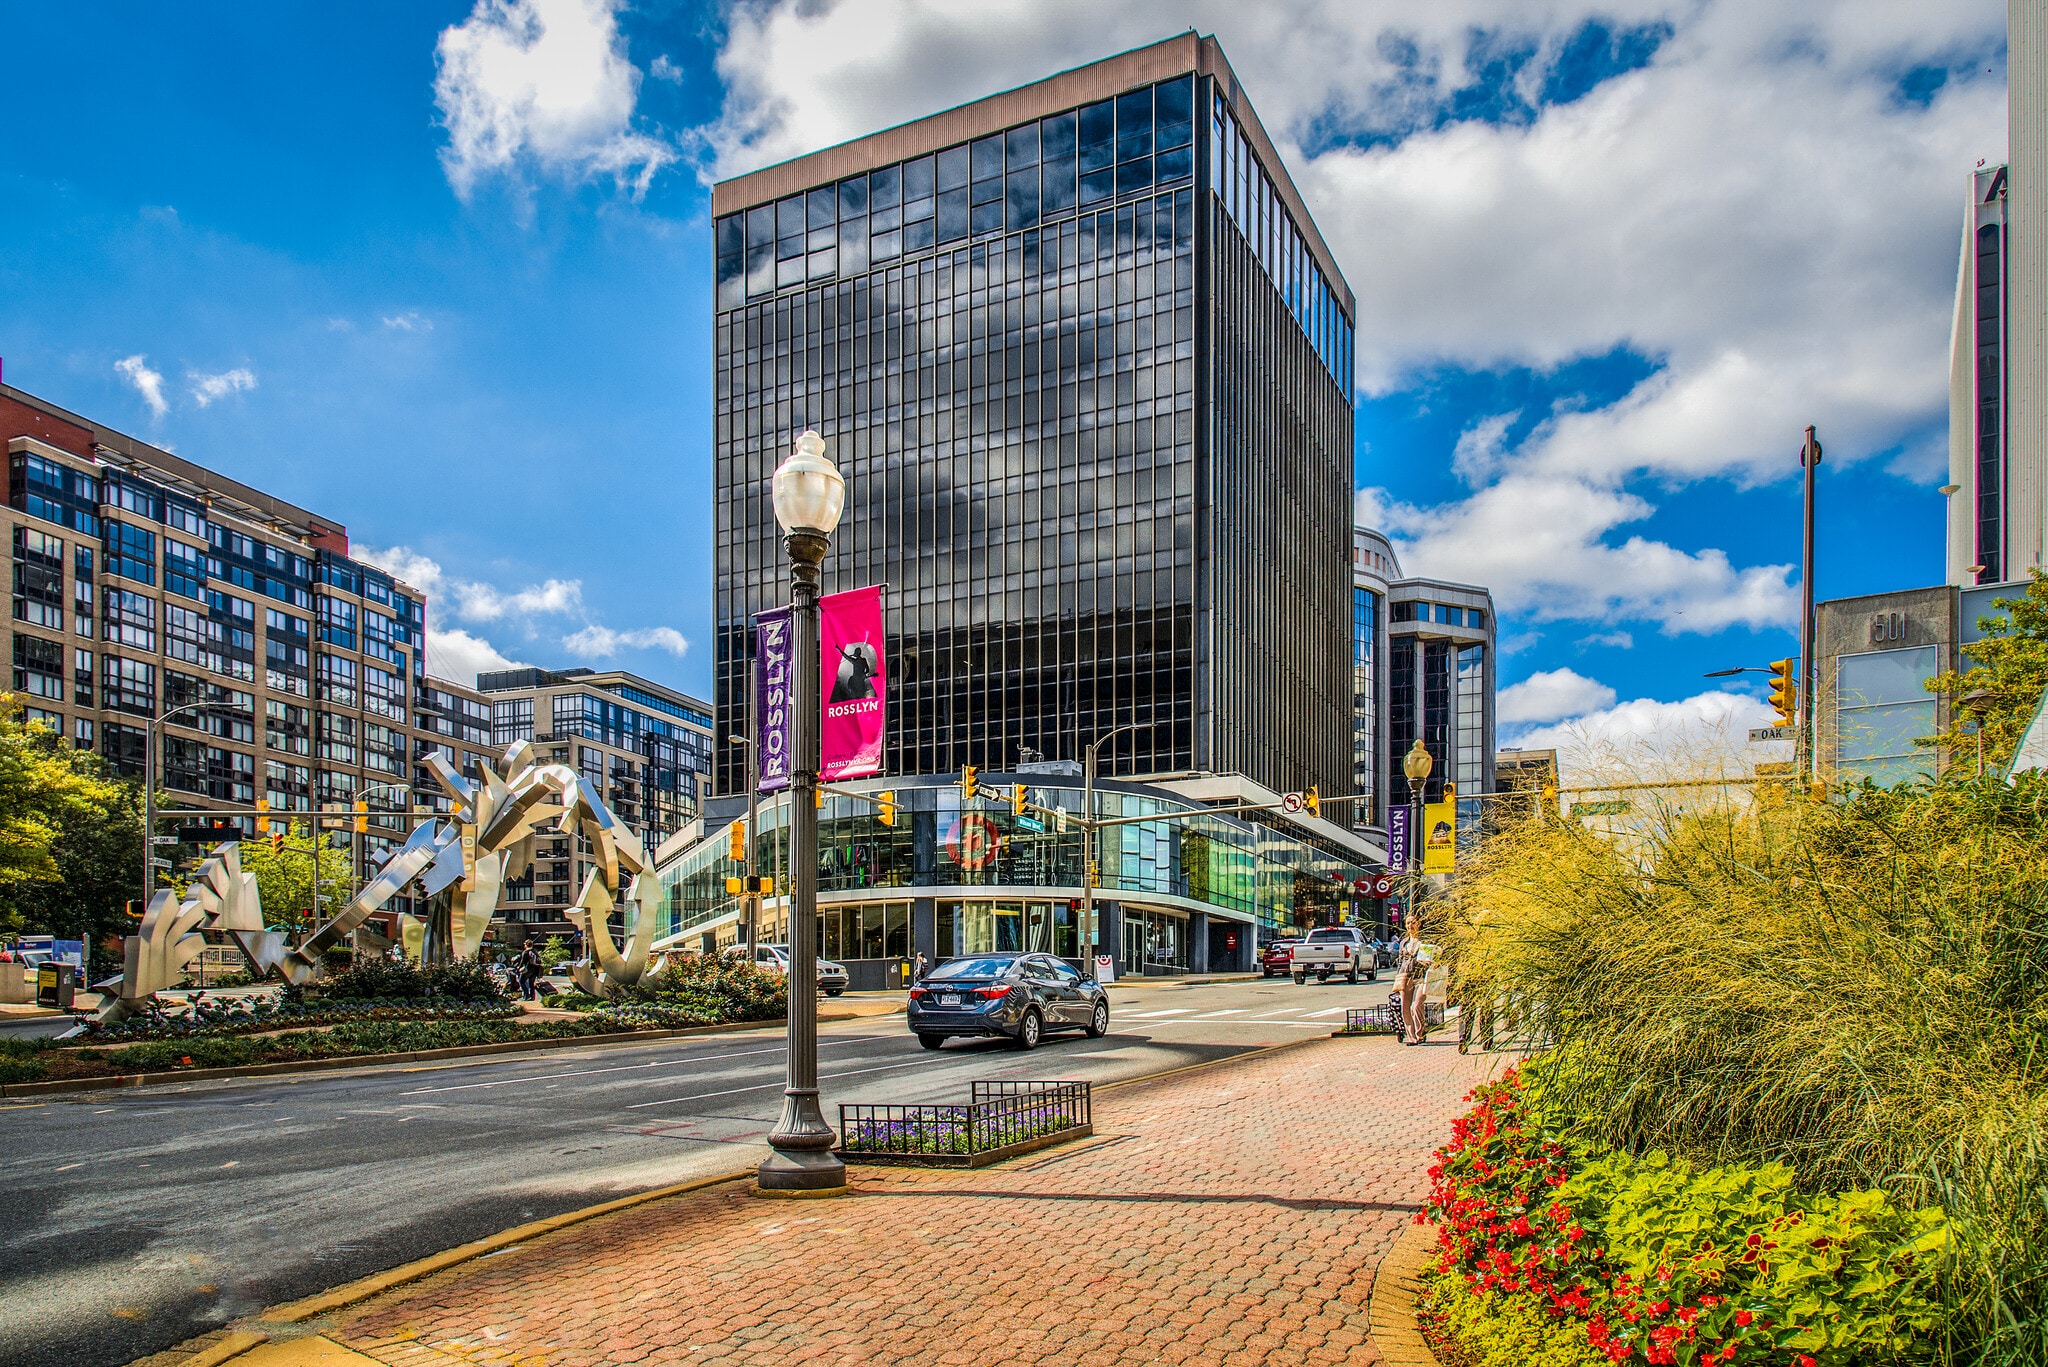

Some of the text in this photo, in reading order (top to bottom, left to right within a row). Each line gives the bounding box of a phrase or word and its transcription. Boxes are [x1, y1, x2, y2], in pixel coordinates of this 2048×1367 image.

[766, 620, 785, 777] ROSSLYN
[828, 700, 879, 718] ROSSLYN
[1761, 728, 1782, 740] OAK
[1392, 810, 1404, 871] ROSSLYN
